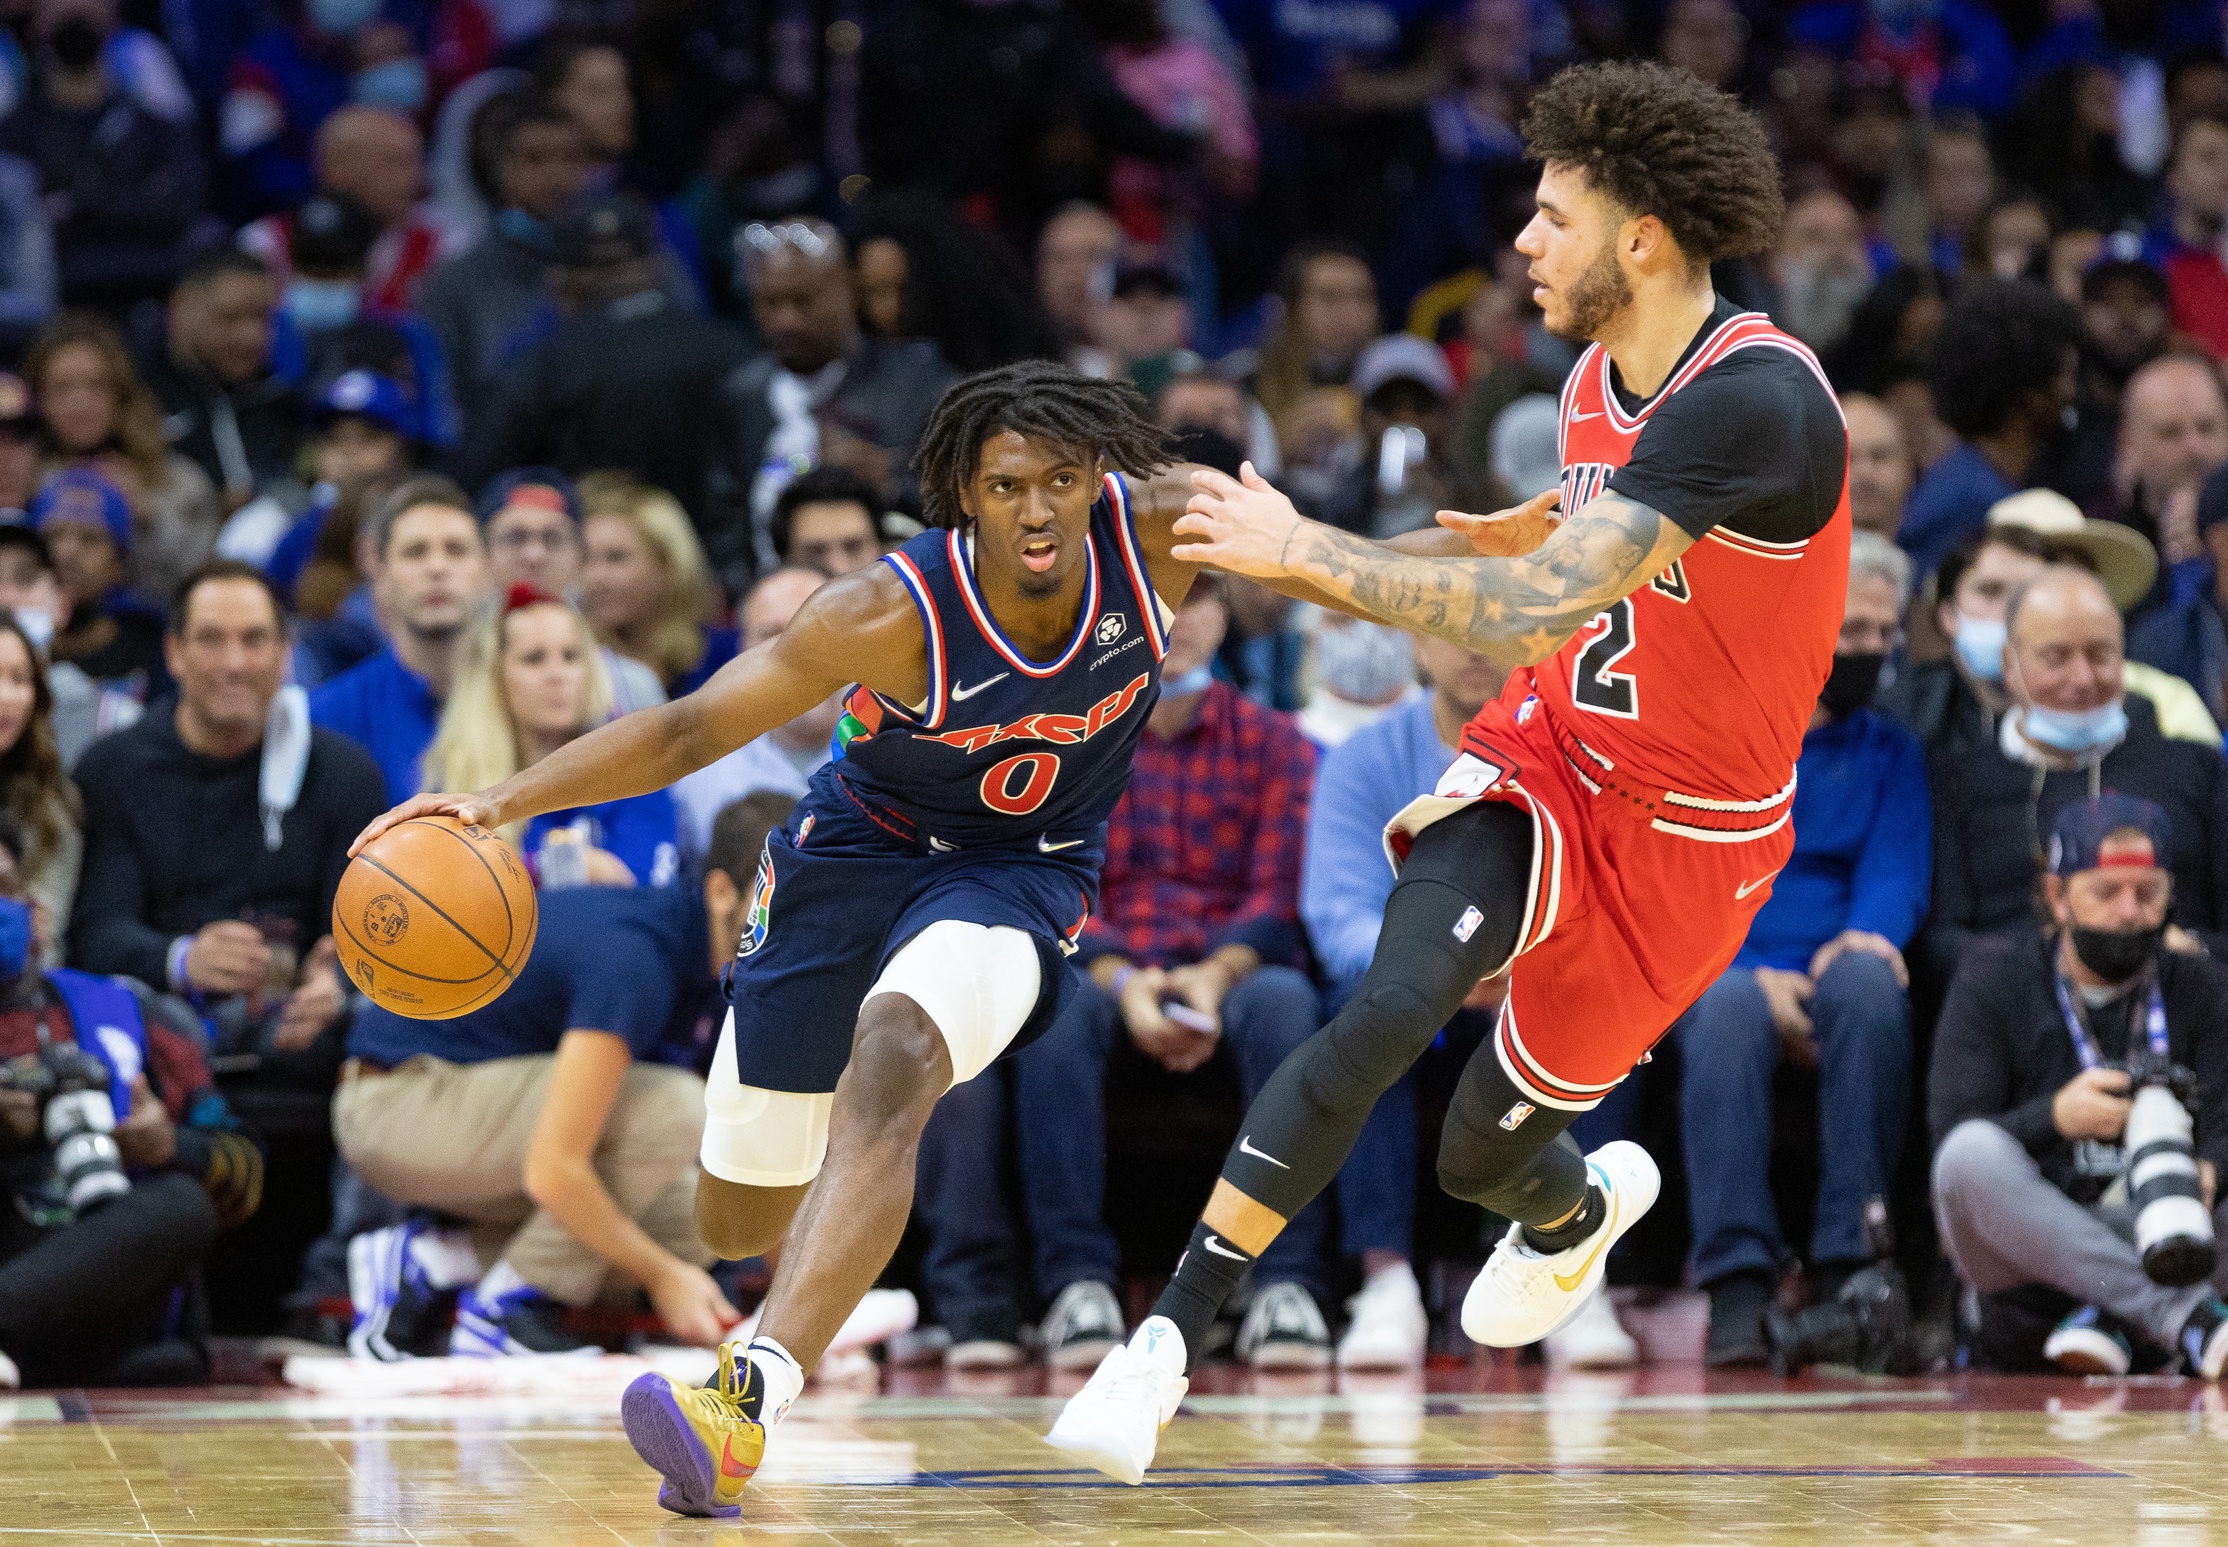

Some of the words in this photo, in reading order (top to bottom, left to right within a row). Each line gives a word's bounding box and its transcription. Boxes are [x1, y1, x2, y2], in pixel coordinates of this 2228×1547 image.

[1089, 635, 1145, 671] crypto.com
[1572, 596, 1640, 721] 2
[979, 752, 1061, 816] 0
